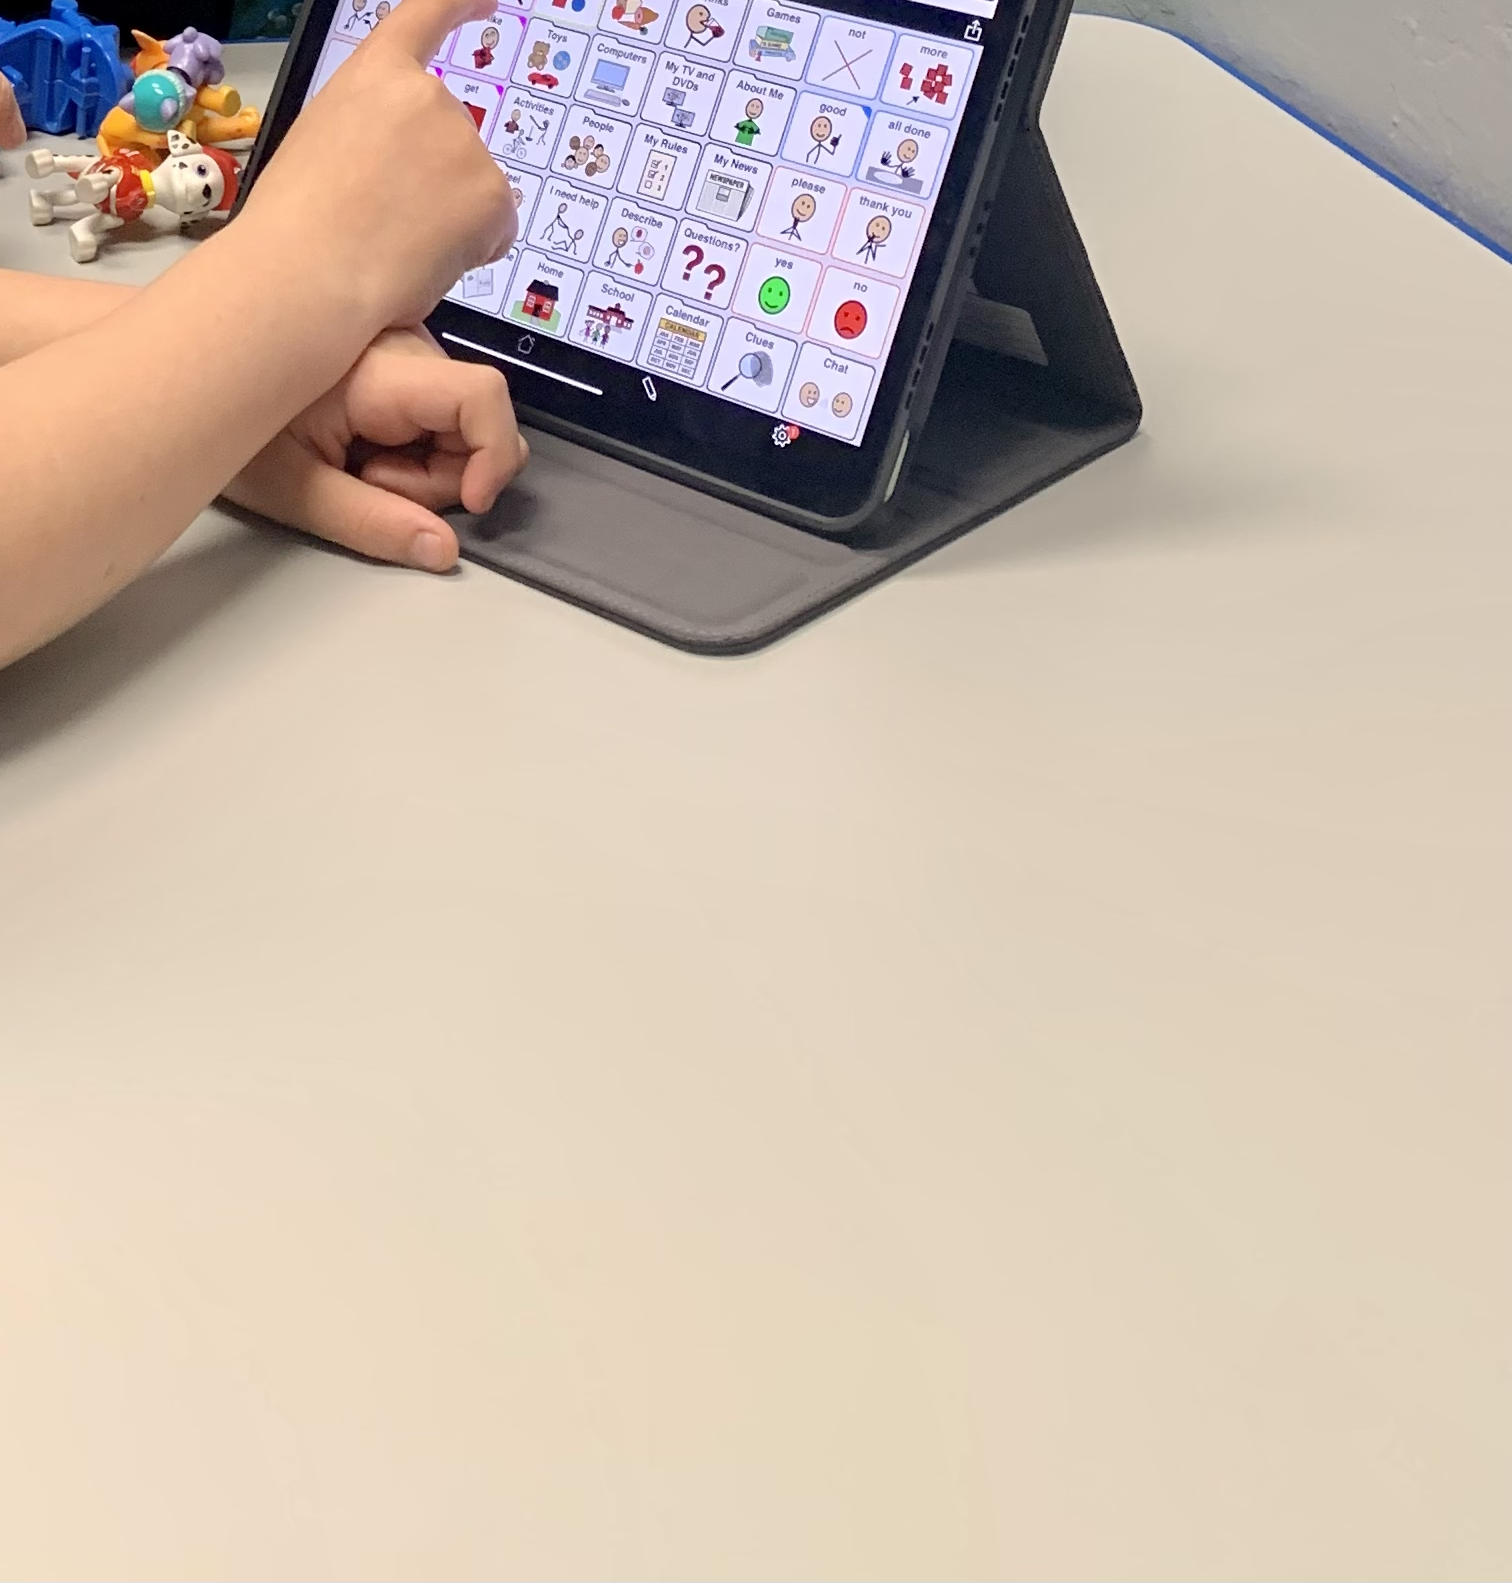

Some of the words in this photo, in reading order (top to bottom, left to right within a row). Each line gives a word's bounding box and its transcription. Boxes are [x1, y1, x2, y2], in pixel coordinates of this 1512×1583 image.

[767, 8, 801, 24] Games
[547, 29, 568, 43] Toys
[848, 27, 866, 40] not
[597, 43, 647, 64] Computers
[920, 45, 948, 59] more
[665, 61, 681, 75] My
[681, 65, 696, 78] TV
[696, 69, 715, 82] and
[464, 83, 479, 94] get
[672, 77, 699, 91] DVDs
[736, 79, 768, 95] About
[769, 87, 784, 100] Me
[513, 96, 555, 116] Activities
[819, 103, 847, 117] good
[582, 116, 614, 133] People
[888, 121, 903, 132] all
[904, 124, 931, 139] done
[644, 134, 660, 148] My
[661, 138, 688, 154] Rules
[713, 154, 730, 168] My
[731, 158, 759, 175] News
[791, 177, 826, 195] please
[555, 187, 577, 202] need
[578, 194, 600, 210] help
[859, 195, 889, 212] thank
[891, 204, 913, 219] you
[621, 208, 663, 229] Describe
[683, 227, 741, 253] Questions?
[537, 262, 564, 279] Home
[774, 256, 794, 270] yes
[601, 284, 635, 303] School
[853, 281, 868, 293] no
[665, 305, 710, 328] Calendar
[745, 332, 774, 350] Clues
[823, 357, 849, 375] Chat
